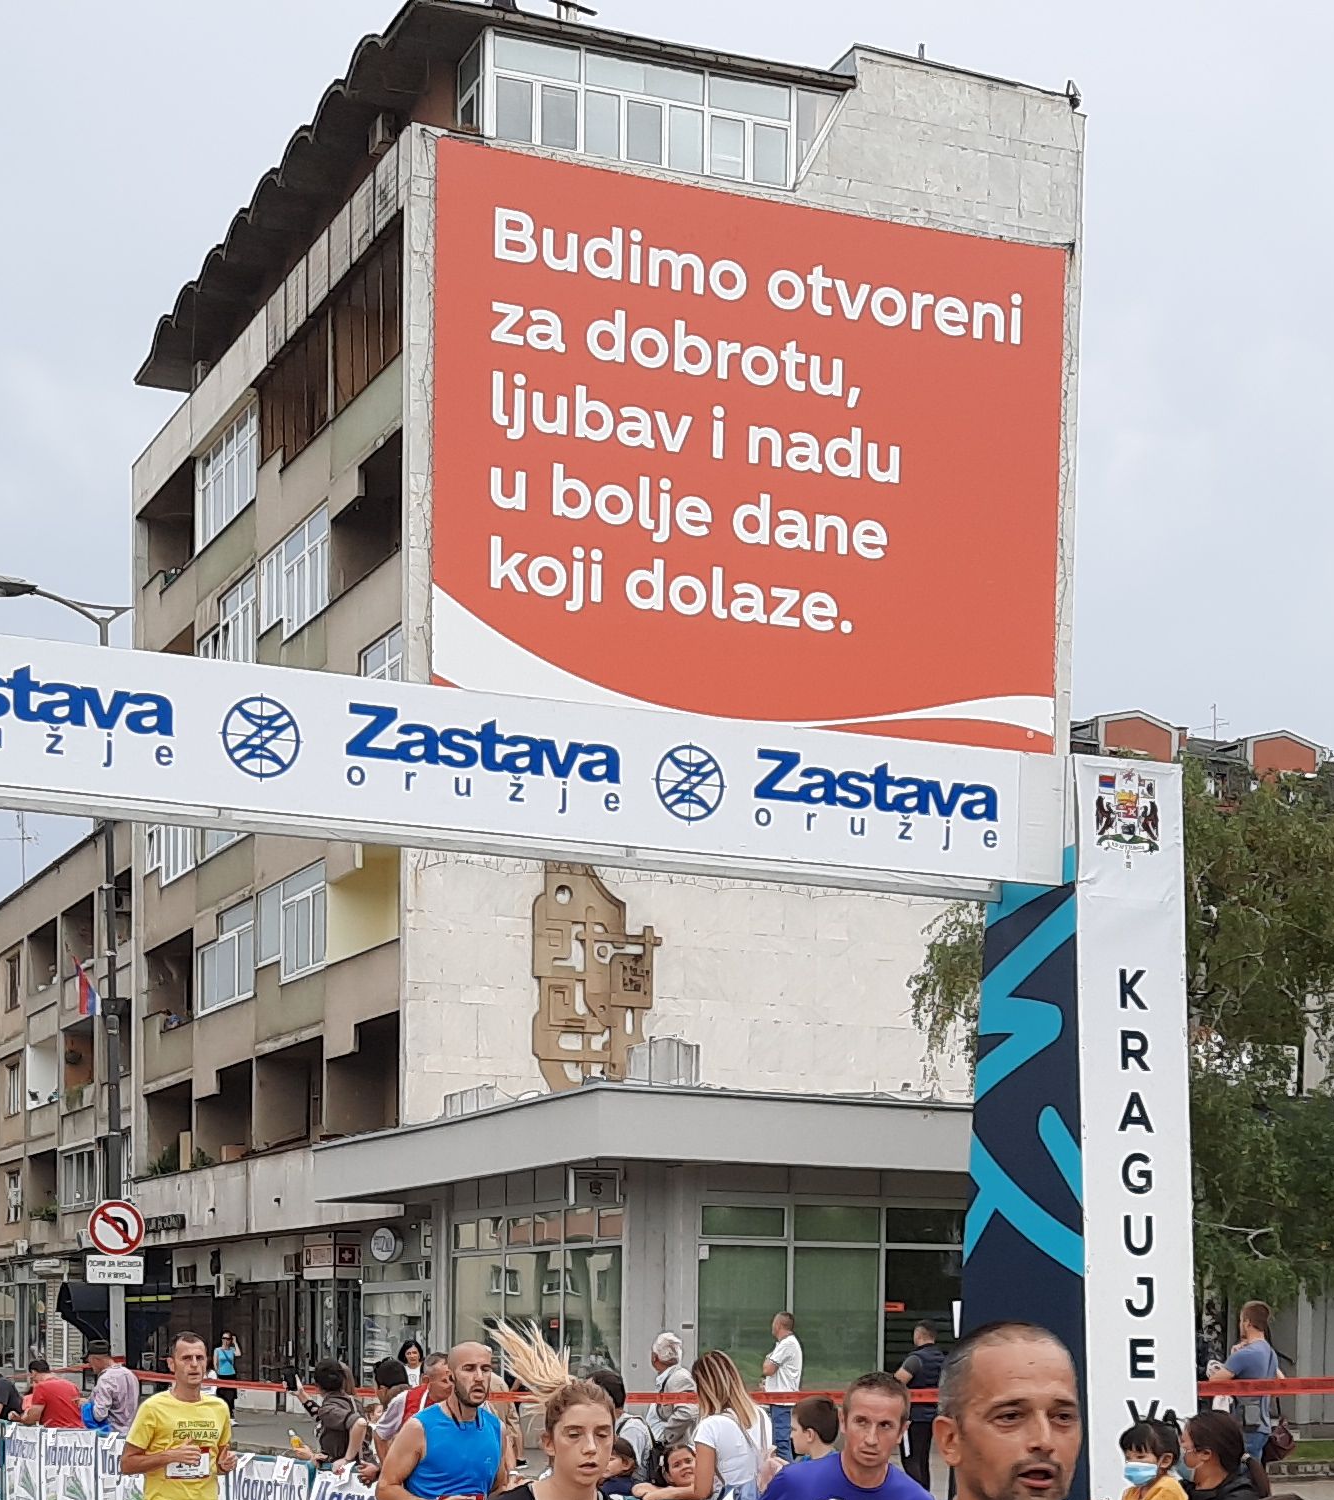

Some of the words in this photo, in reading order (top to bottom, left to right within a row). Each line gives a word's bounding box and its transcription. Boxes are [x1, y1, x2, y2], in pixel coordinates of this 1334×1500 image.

[493, 206, 748, 301] Budimo
[767, 263, 1023, 345] otvoreni
[490, 301, 565, 354] za
[585, 309, 862, 408] dobrotu,
[491, 370, 693, 453] ljubav
[711, 405, 725, 460] i
[747, 427, 901, 485] nadu
[489, 465, 526, 511] u
[551, 462, 712, 543] bolje
[732, 494, 888, 560] dane
[488, 535, 603, 612] koji
[624, 558, 854, 634] dolaze.
[346, 701, 620, 785] Zastava
[346, 764, 620, 814] oružje
[753, 748, 998, 823] Zastava
[755, 804, 998, 850] oružje
